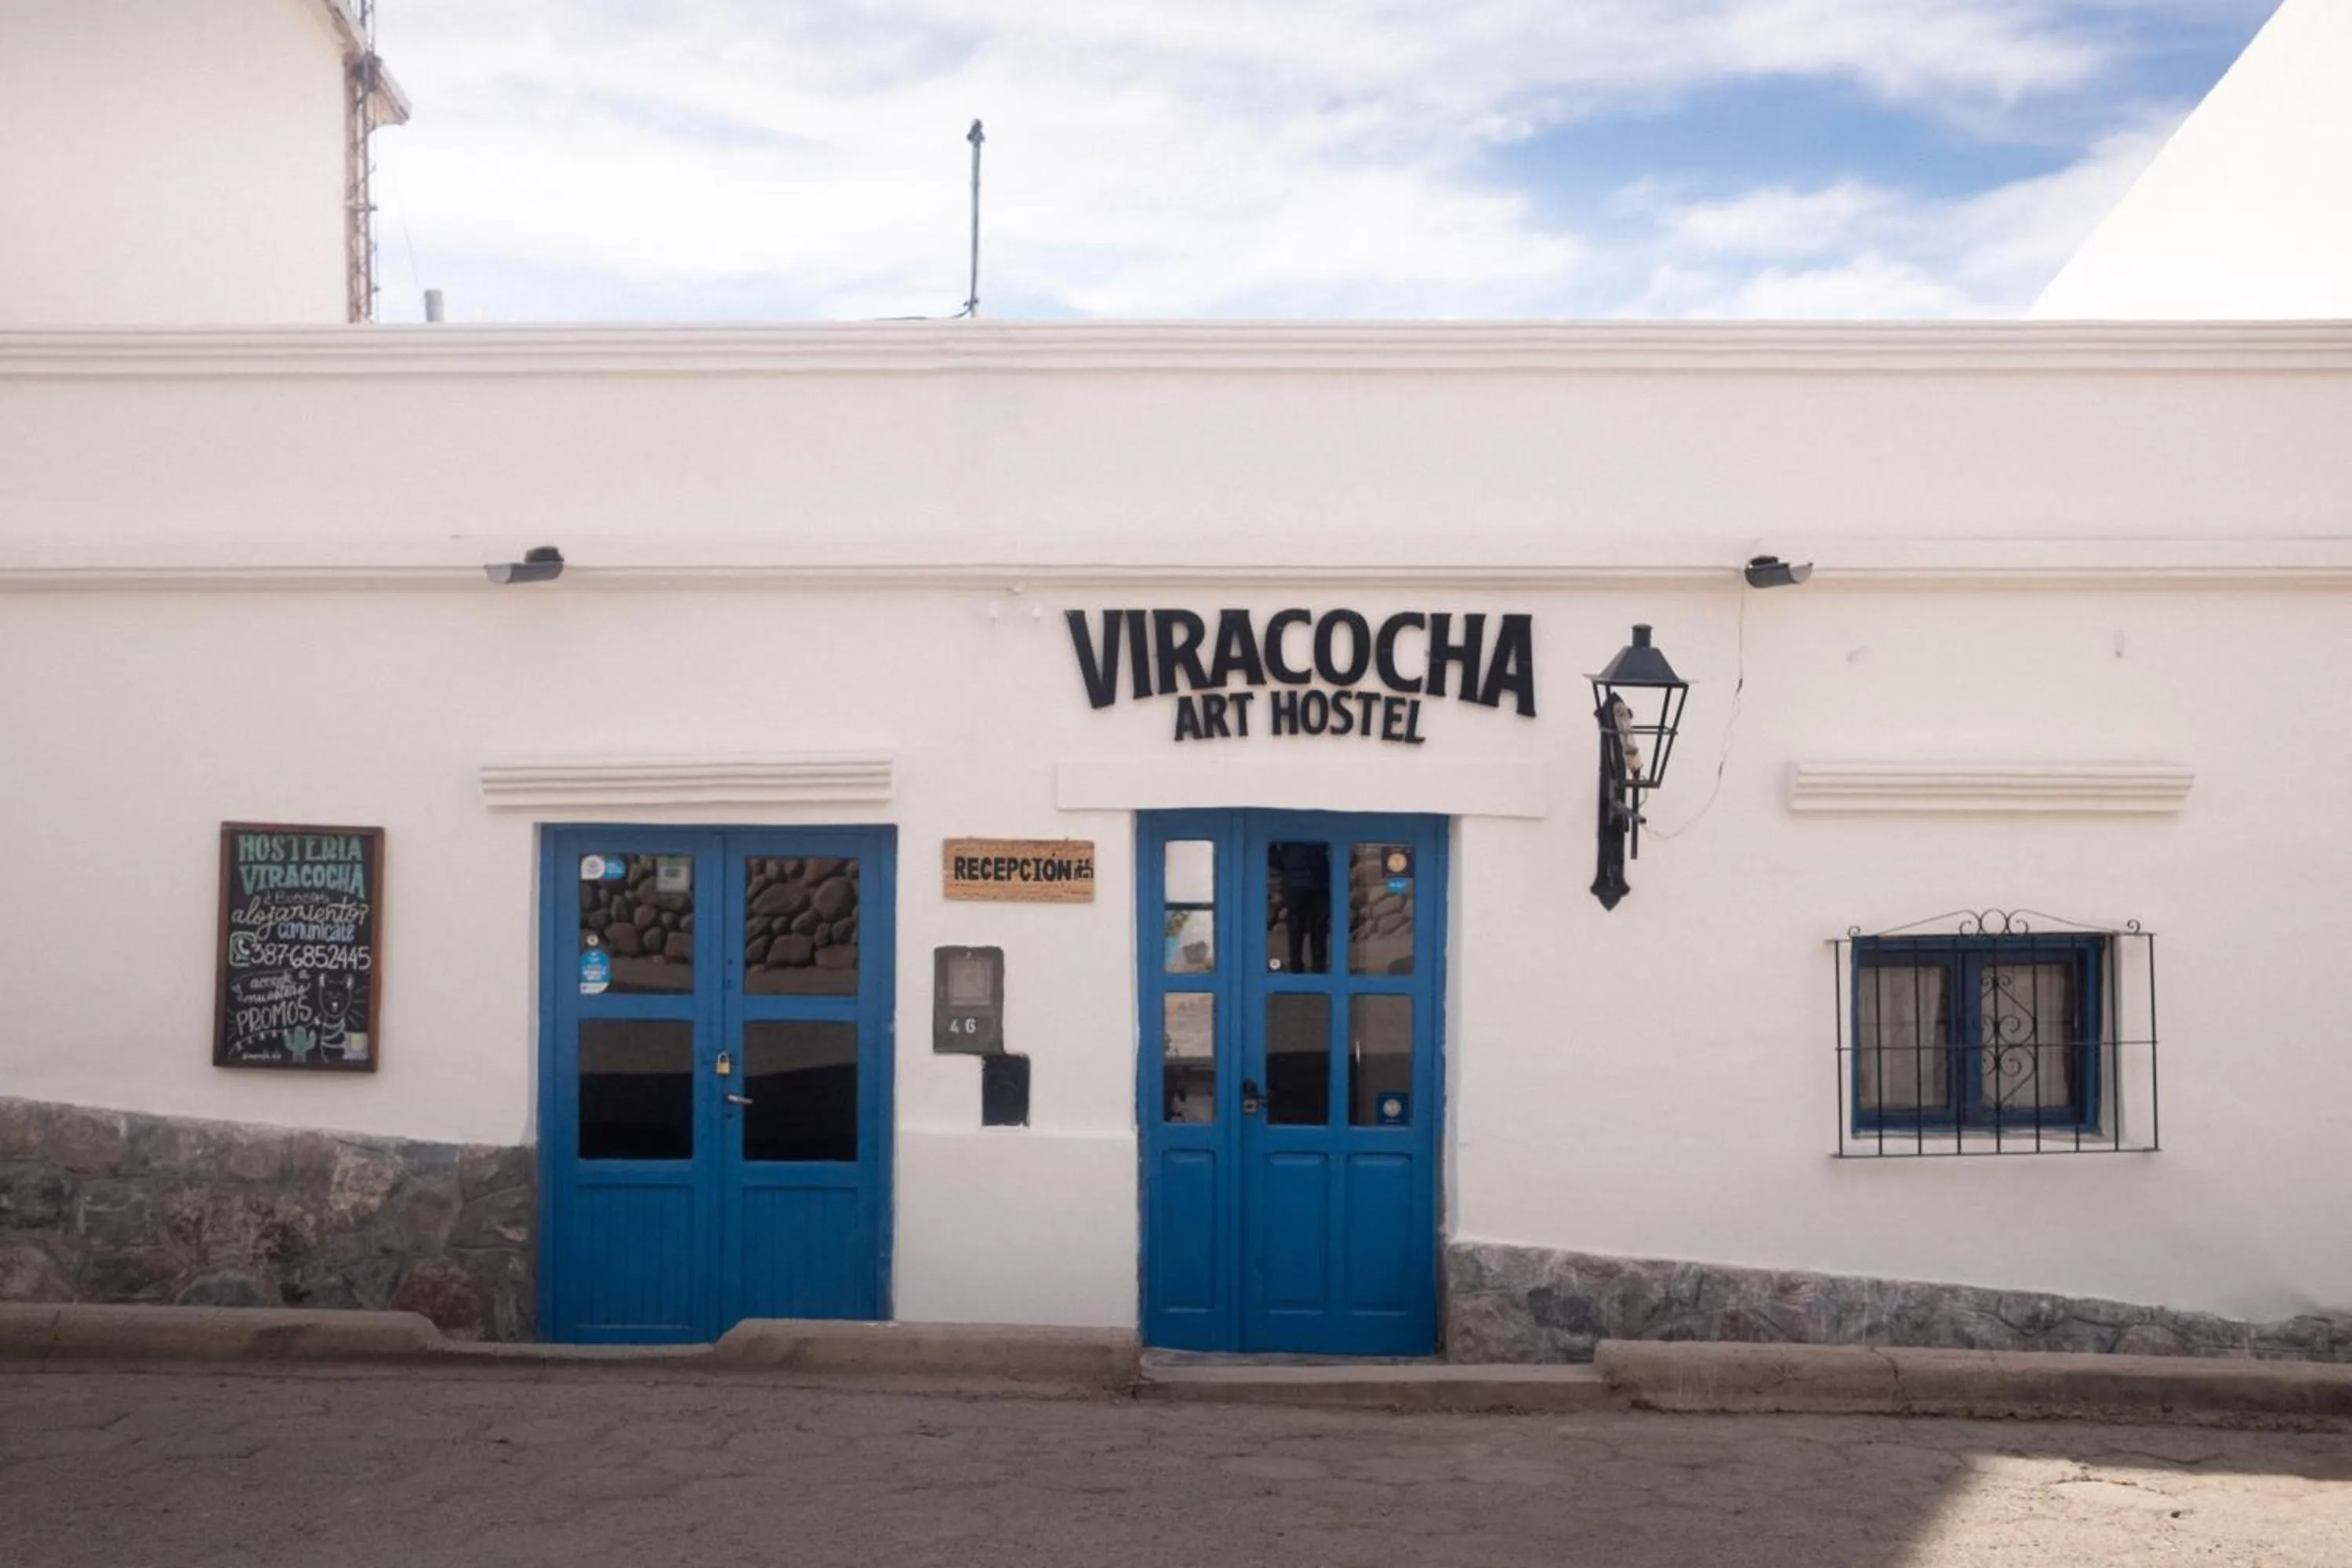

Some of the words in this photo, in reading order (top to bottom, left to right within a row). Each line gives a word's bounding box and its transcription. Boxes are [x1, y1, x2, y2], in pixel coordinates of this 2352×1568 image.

[1065, 608, 1537, 717] VIRACOCHA
[1174, 691, 1254, 742] ART
[1271, 690, 1426, 744] HOSTEL
[238, 833, 363, 862] HOSTERIA
[238, 864, 365, 899] VIRACOCHA
[237, 995, 312, 1036] PROMOS
